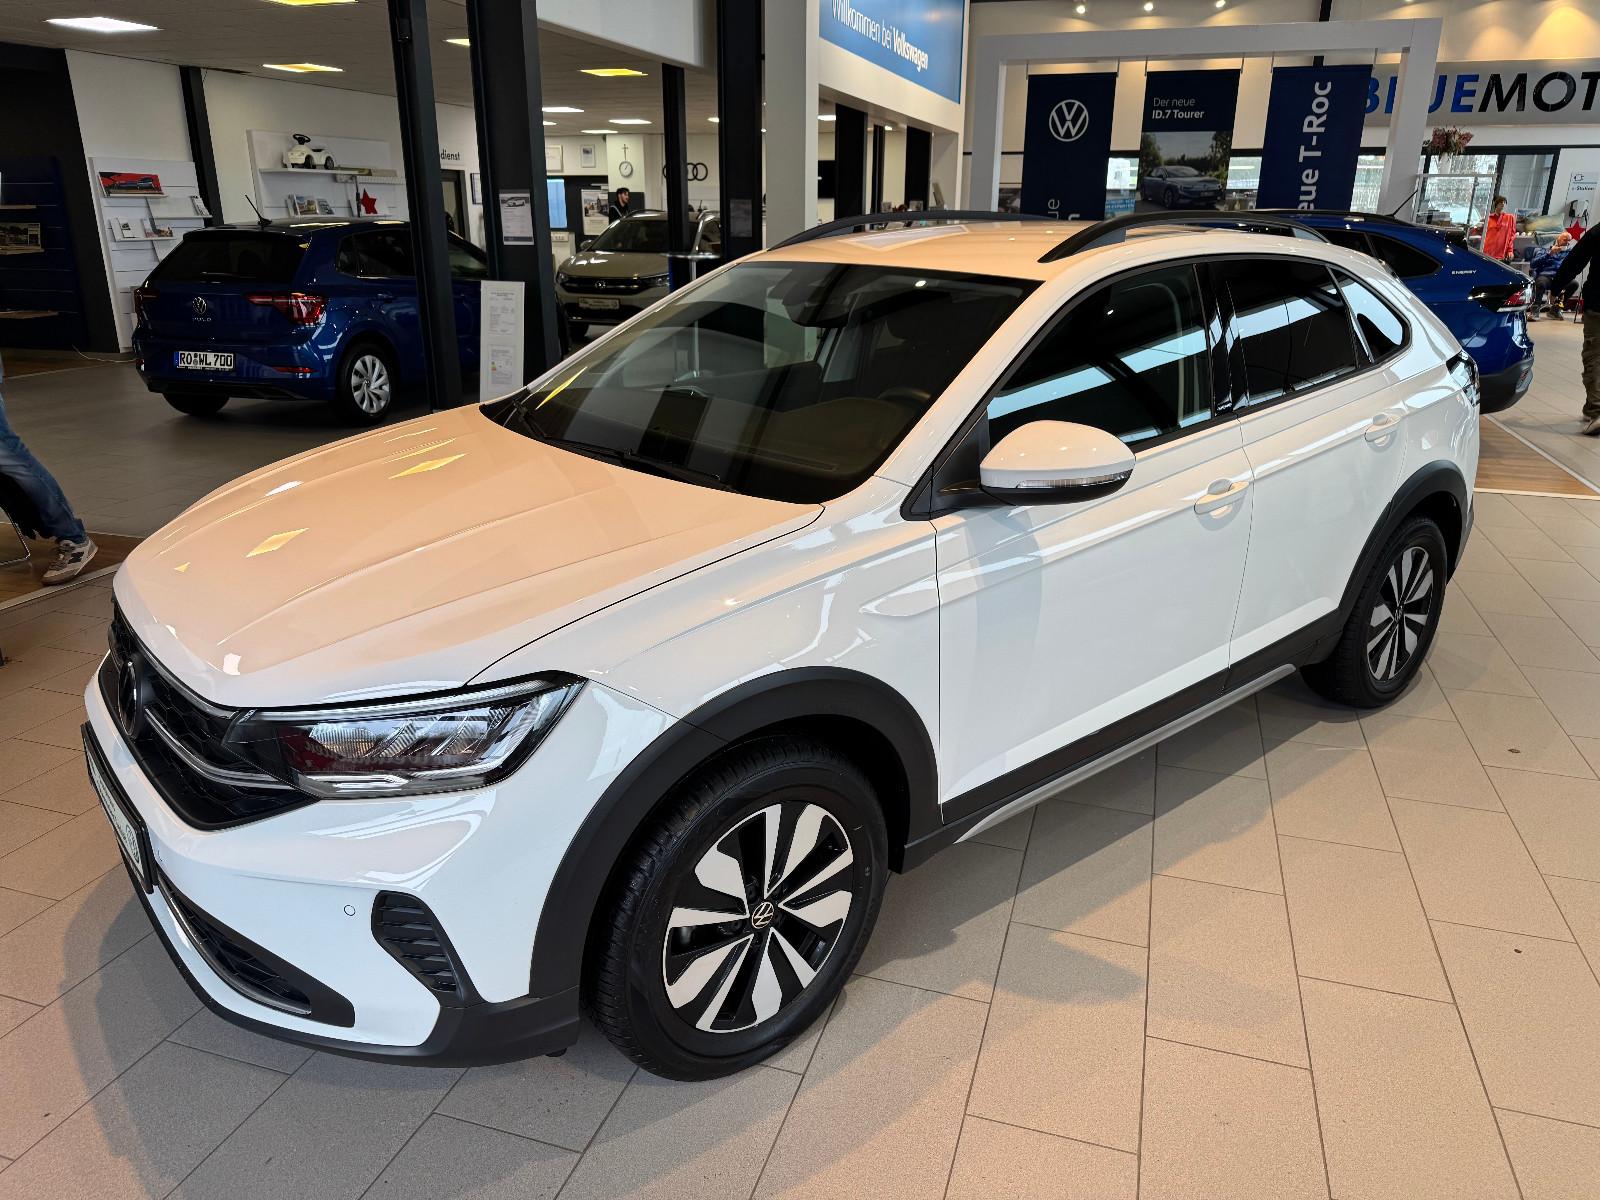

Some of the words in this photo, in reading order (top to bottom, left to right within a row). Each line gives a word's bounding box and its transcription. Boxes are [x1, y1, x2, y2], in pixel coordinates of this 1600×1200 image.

[831, 0, 880, 43] Willkommen
[881, 19, 893, 51] bei
[893, 26, 929, 72] Volkswagen
[1153, 97, 1170, 107] Der
[1171, 98, 1196, 107] neue
[1152, 109, 1171, 119] ID.7
[1172, 109, 1205, 119] Tourer
[1298, 81, 1332, 163] T-Roc
[179, 352, 192, 365] RO
[198, 353, 212, 366] WL
[213, 353, 233, 367] 700
